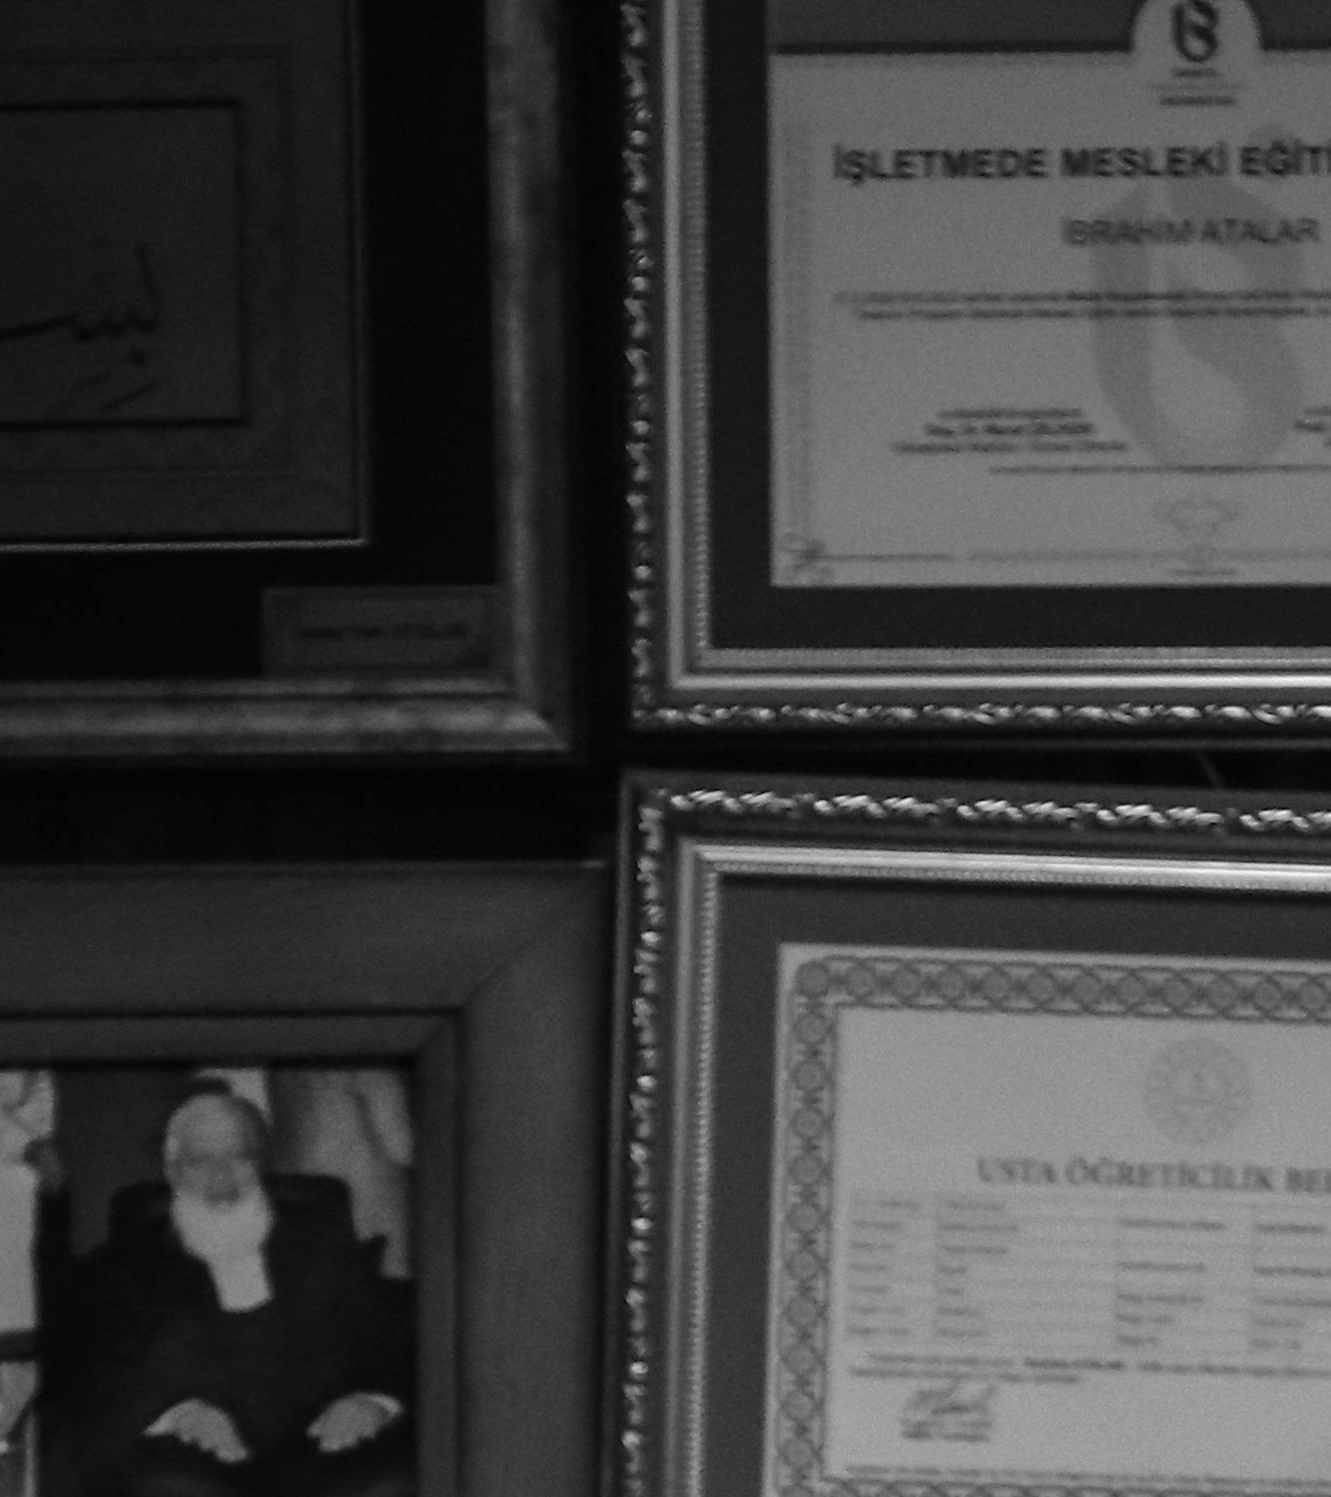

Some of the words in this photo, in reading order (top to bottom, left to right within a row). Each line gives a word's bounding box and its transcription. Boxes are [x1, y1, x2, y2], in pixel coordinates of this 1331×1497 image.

[831, 143, 1051, 187] İŞLETMEDE
[1061, 139, 1228, 178] MESLEKİ
[1202, 215, 1321, 245] ATALAR
[976, 1156, 1058, 1185] USTA
